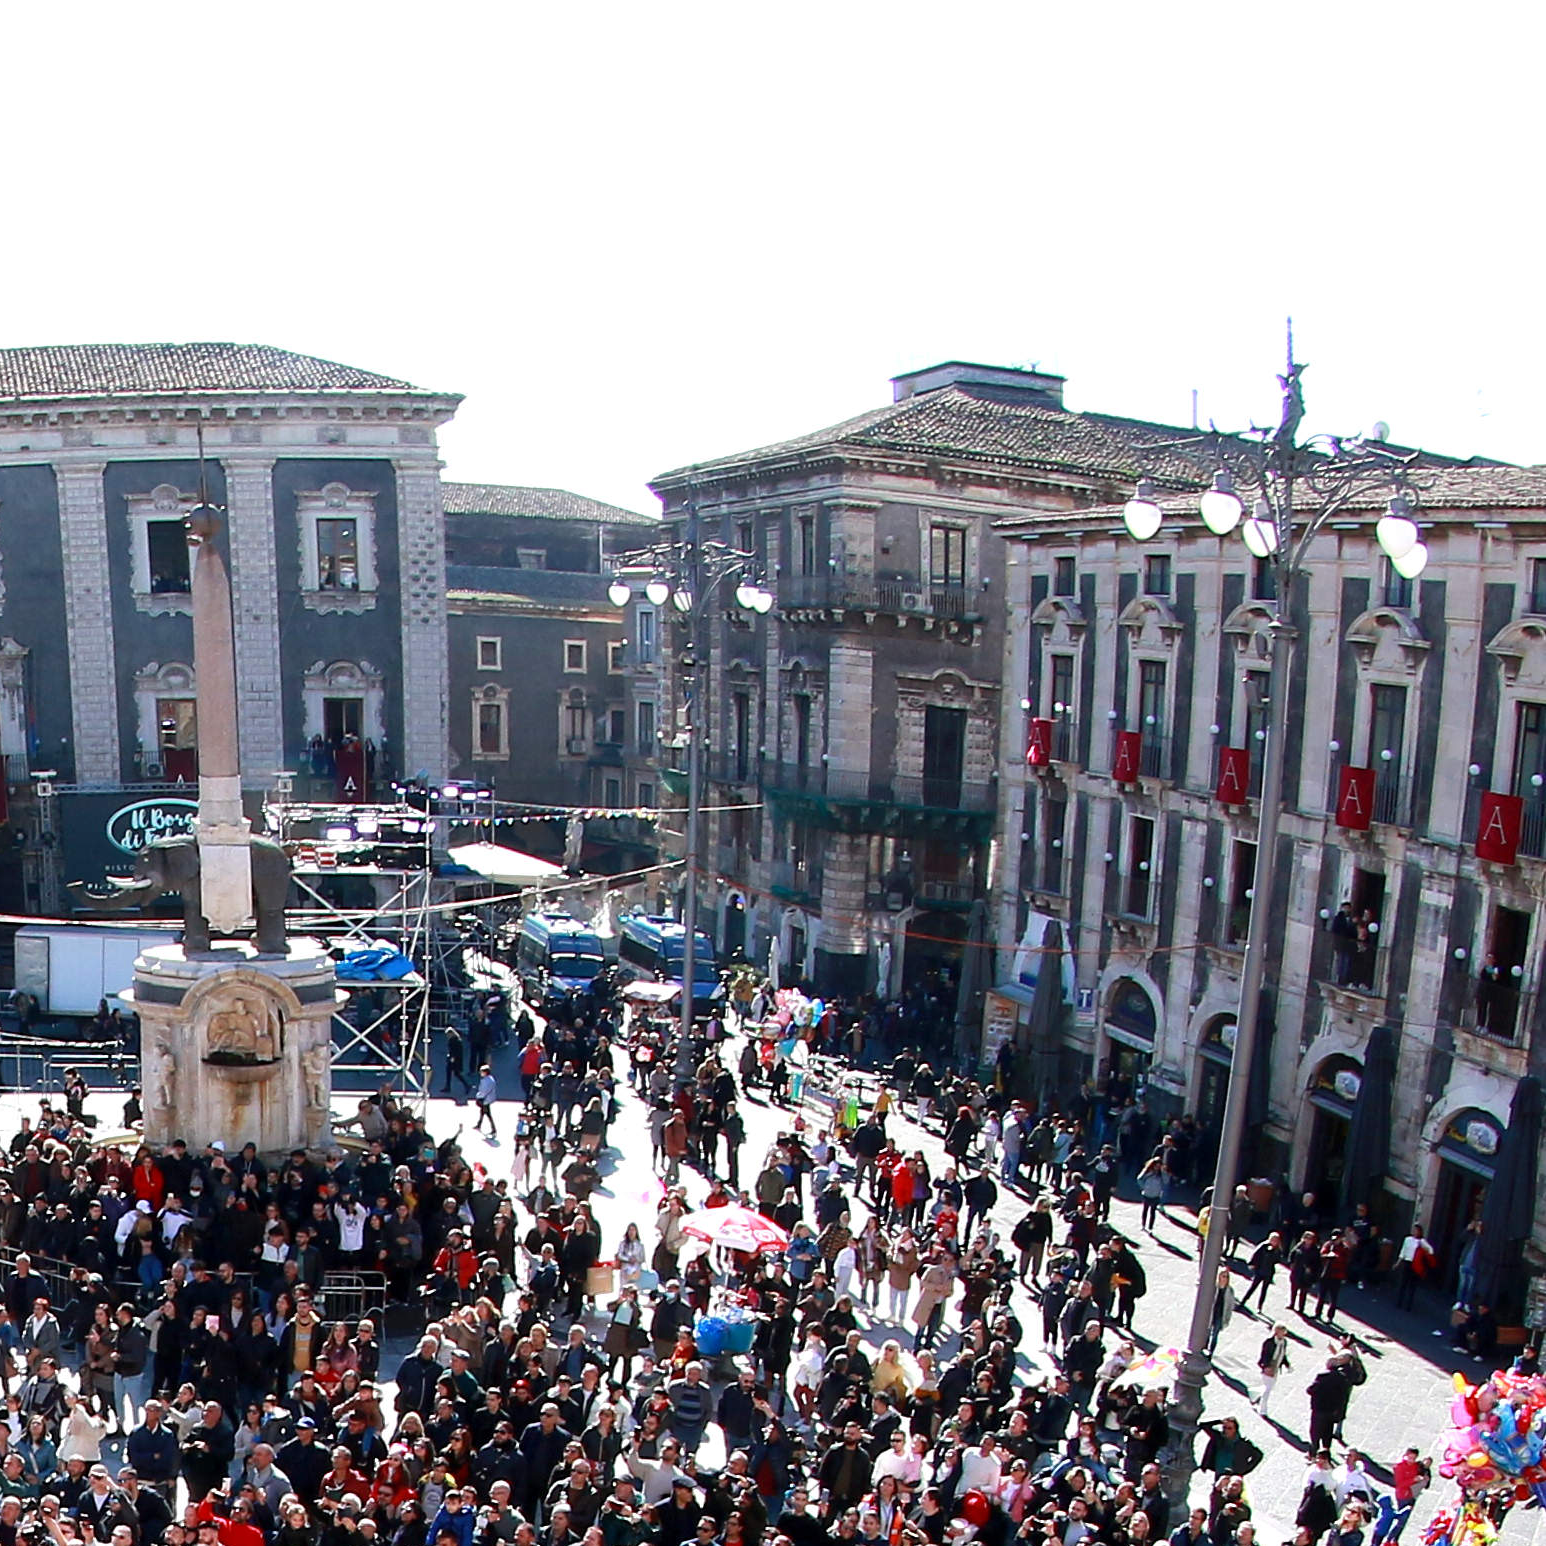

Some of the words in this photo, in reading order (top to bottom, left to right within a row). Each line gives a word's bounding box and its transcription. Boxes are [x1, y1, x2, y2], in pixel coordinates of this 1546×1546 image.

[1116, 741, 1131, 771] A
[344, 776, 357, 791] A
[1221, 756, 1240, 790] A
[1343, 779, 1362, 814] A
[131, 808, 149, 829] Il
[151, 808, 200, 834] Borg
[1484, 806, 1506, 844] A
[121, 830, 142, 848] di
[1080, 989, 1091, 1008] T
